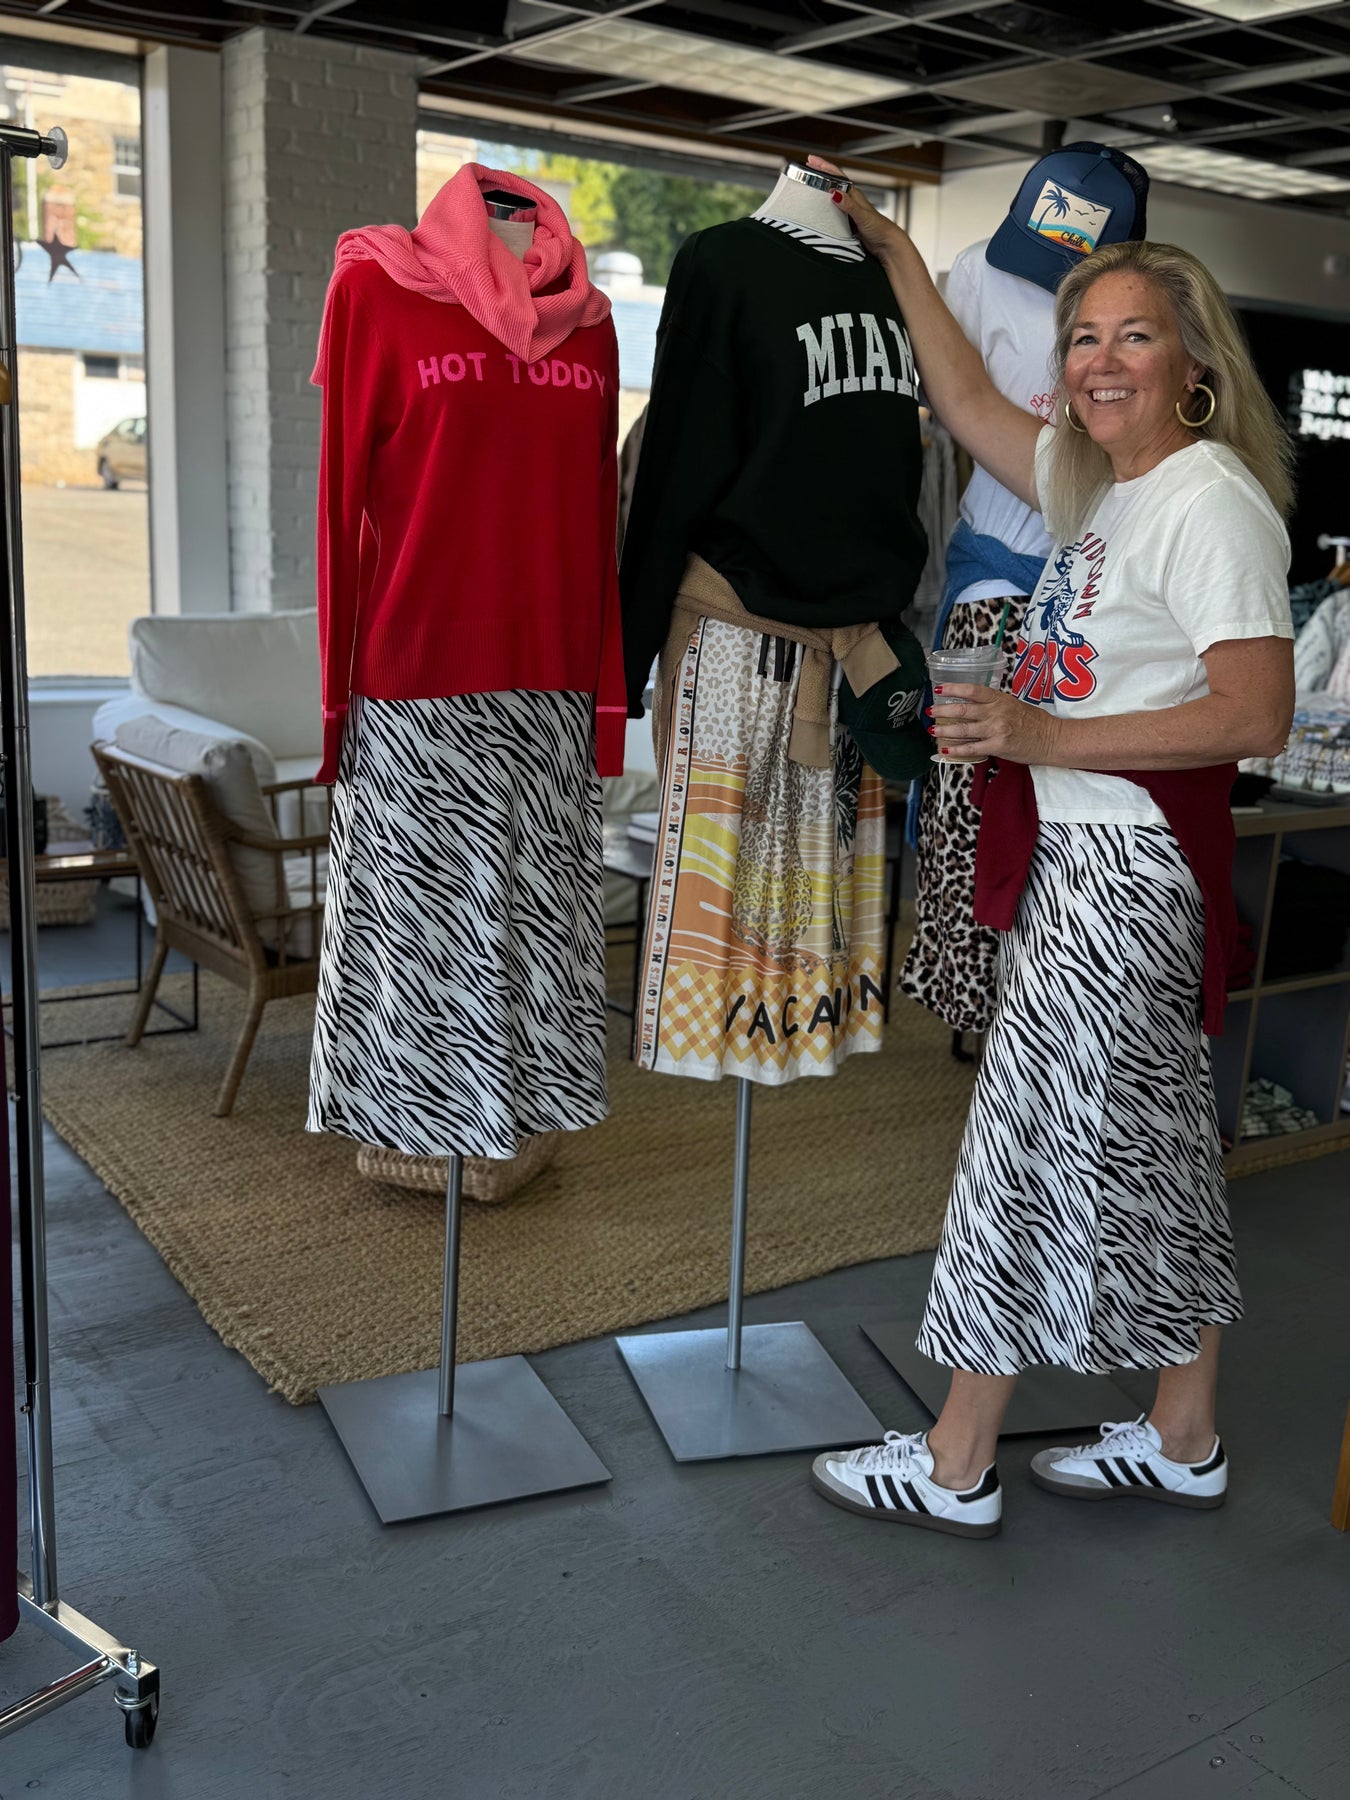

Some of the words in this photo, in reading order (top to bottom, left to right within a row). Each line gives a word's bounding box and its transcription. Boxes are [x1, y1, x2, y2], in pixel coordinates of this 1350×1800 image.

[1061, 231, 1087, 248] Chill
[418, 352, 486, 389] HOT
[505, 353, 606, 397] TODDY
[796, 313, 919, 407] MIAM
[687, 627, 700, 663] SUM
[682, 680, 694, 700] ME
[678, 703, 692, 743] LOVES
[668, 815, 680, 834] ME
[664, 837, 677, 875] LOVES
[651, 946, 664, 964] ME
